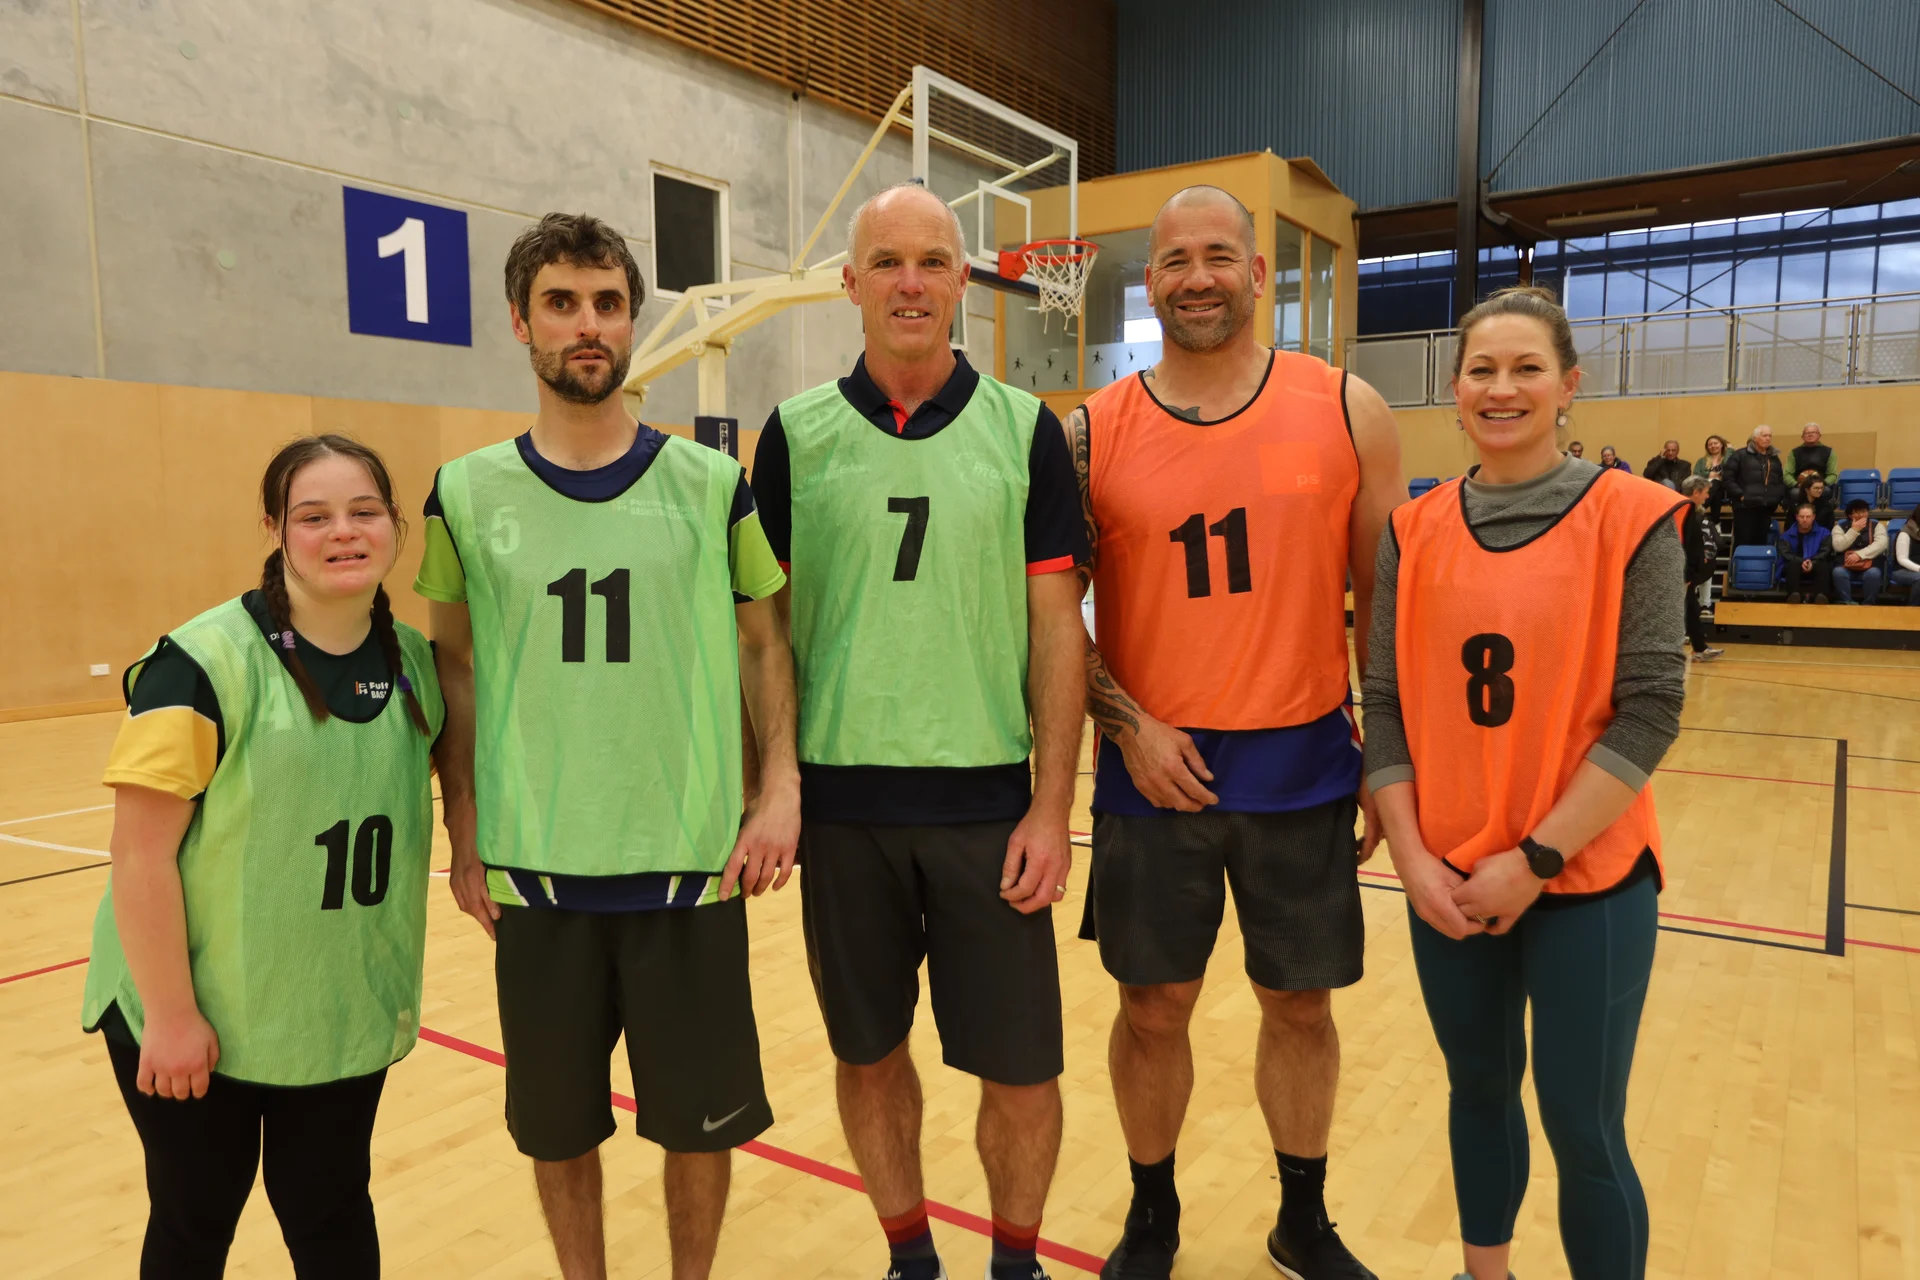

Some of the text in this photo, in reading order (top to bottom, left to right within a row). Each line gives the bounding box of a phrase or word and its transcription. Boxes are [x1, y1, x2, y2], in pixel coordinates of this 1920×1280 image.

[378, 217, 429, 324] 1
[1297, 474, 1319, 488] ps
[491, 506, 520, 555] 5
[888, 496, 930, 582] 7
[1169, 506, 1252, 598] 11
[547, 568, 630, 662] 11
[371, 690, 387, 699] BAS
[1461, 633, 1514, 728] 8
[315, 815, 393, 910] 10
